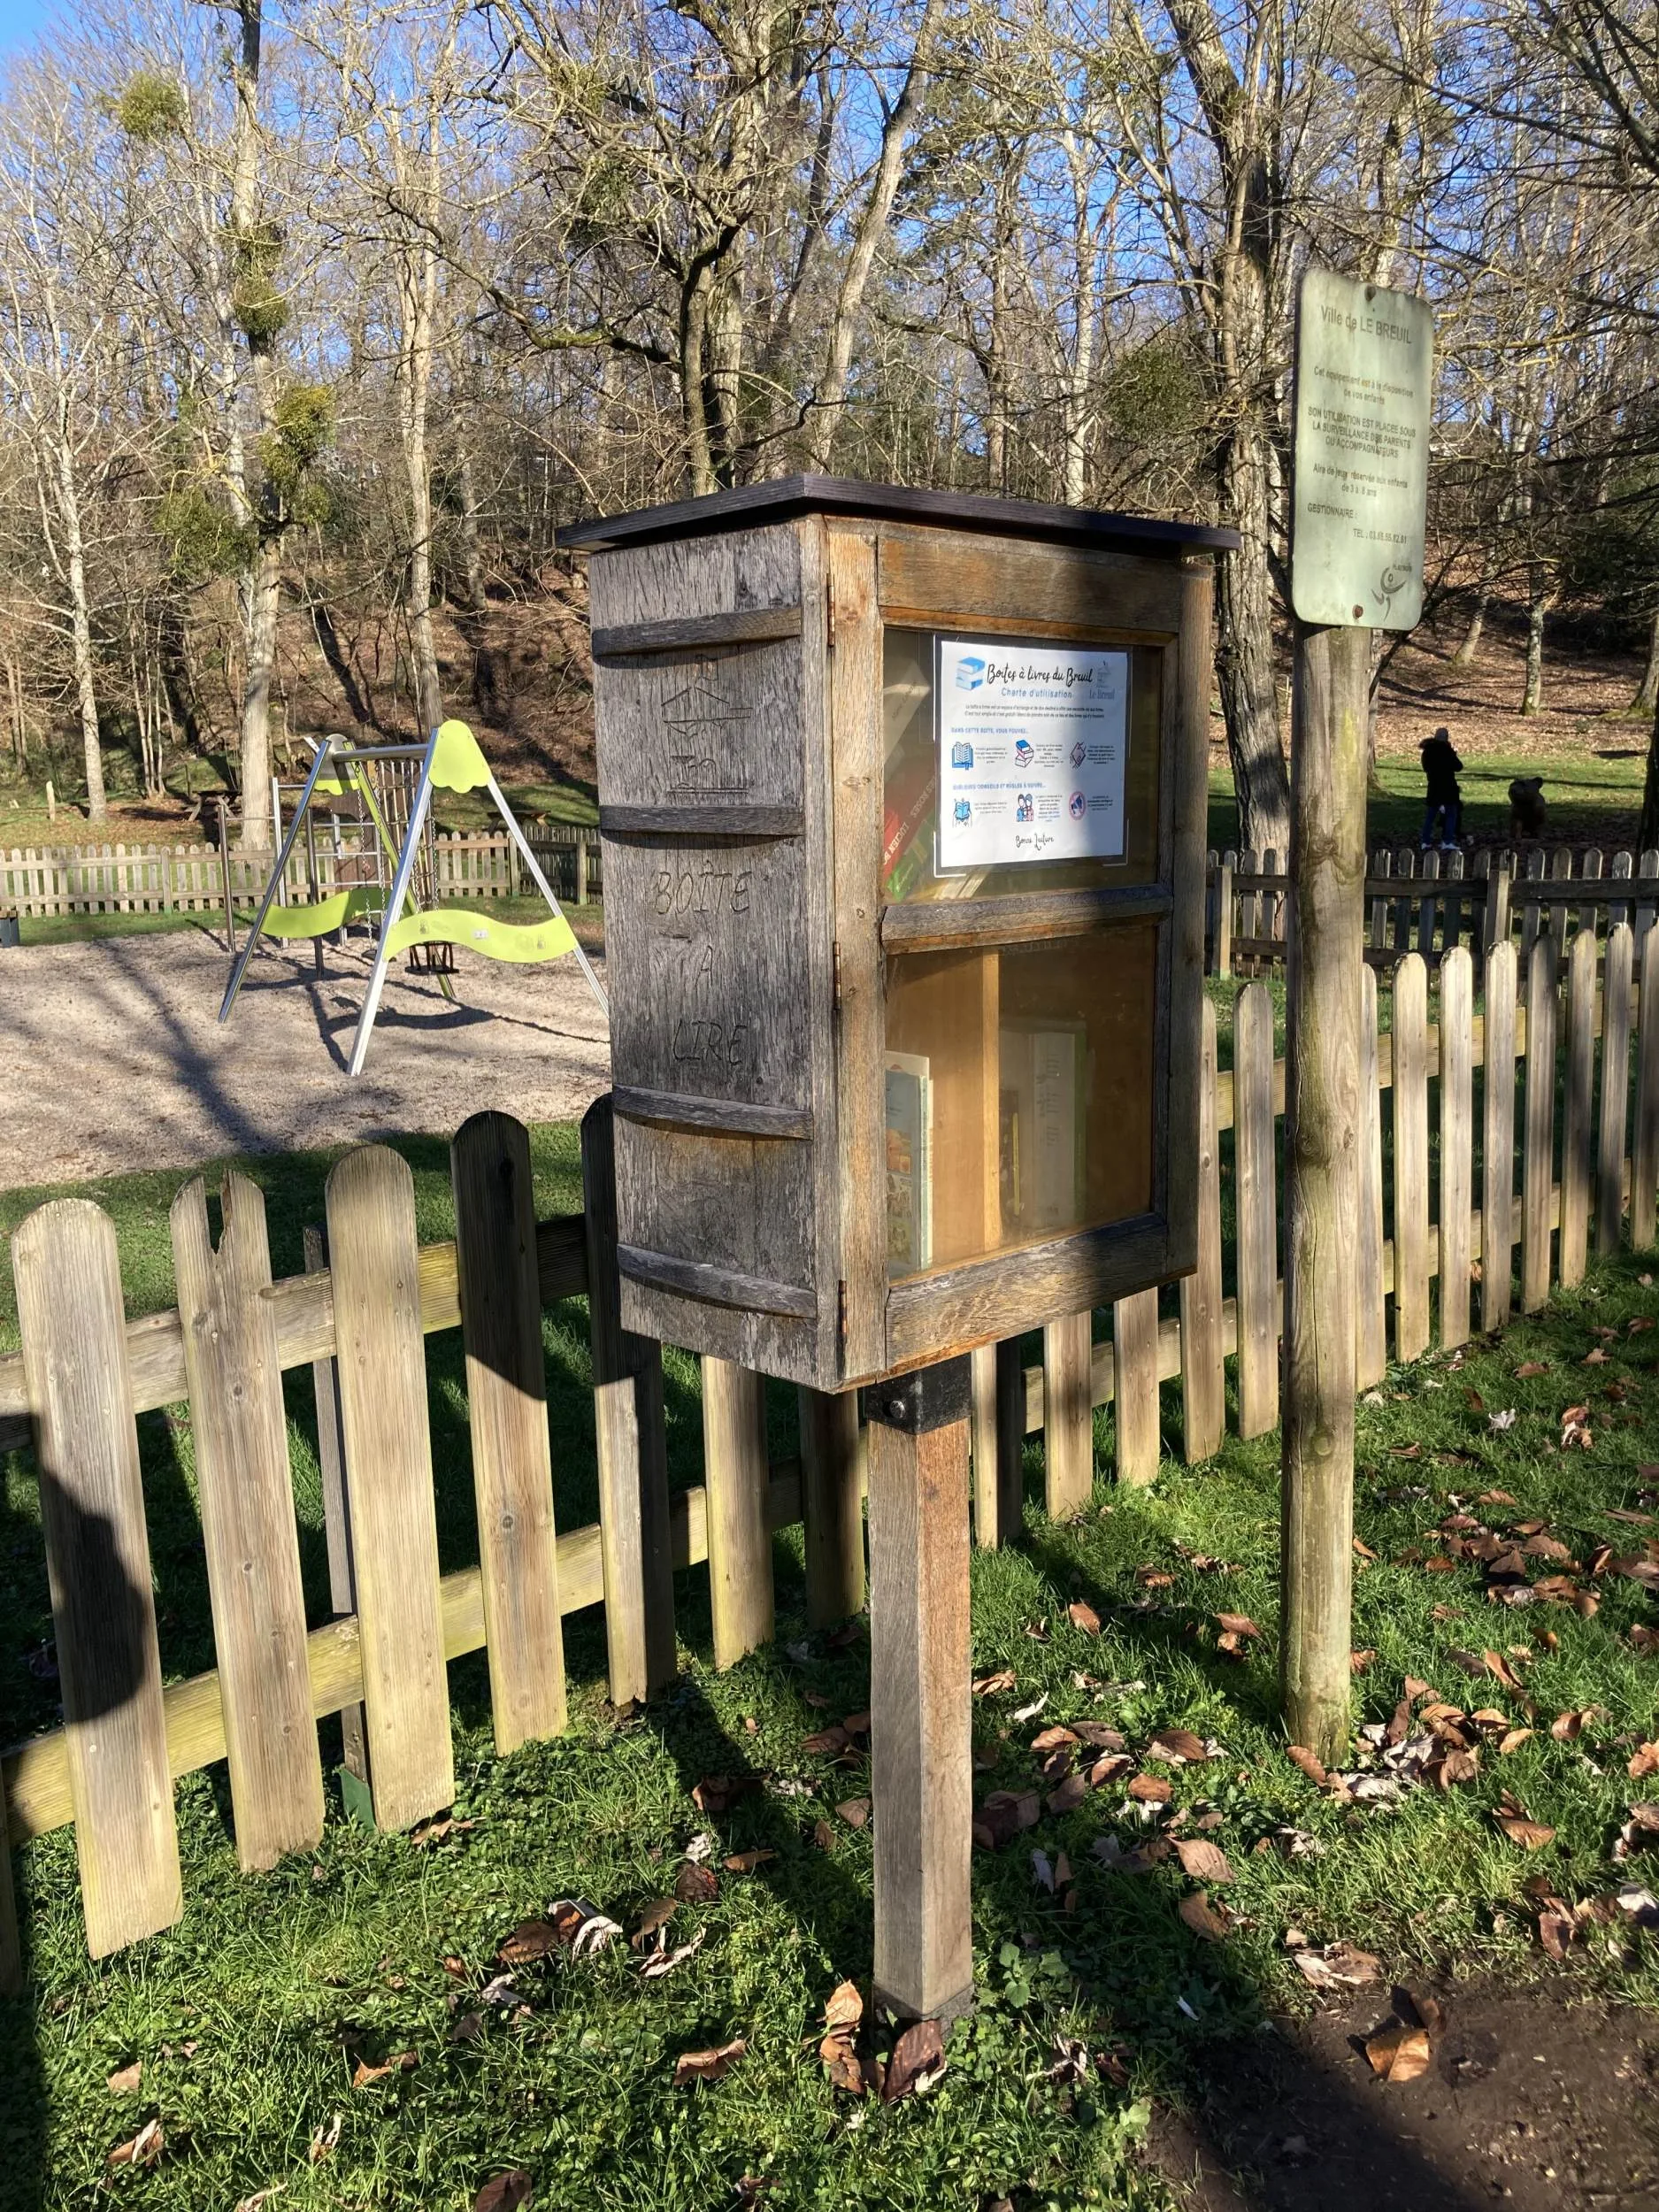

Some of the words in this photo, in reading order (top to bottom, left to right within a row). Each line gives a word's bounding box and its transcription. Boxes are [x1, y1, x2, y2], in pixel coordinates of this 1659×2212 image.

[1321, 304, 1342, 326] Ville
[1345, 313, 1357, 329] de
[1360, 316, 1373, 333] LE
[1376, 320, 1412, 344] BREUIL
[1308, 406, 1322, 418] SON
[1324, 410, 1360, 426] UTILISATION
[1363, 419, 1373, 428] EST
[1400, 426, 1416, 438] SOUS
[1313, 421, 1321, 430] LA
[1322, 423, 1369, 441] SURVEILLANCE
[1371, 434, 1383, 442] DES
[1384, 435, 1410, 449] PARENTS
[1313, 464, 1325, 474] Aire
[1327, 465, 1334, 476] de
[1341, 483, 1349, 493] de
[1308, 503, 1354, 518] GESTIONNAIRE
[1019, 666, 1025, 680] à
[1027, 665, 1050, 683] livres
[1053, 665, 1064, 680] du
[1066, 667, 1093, 687] Breuil
[1002, 687, 1026, 696] Charte
[1029, 689, 1072, 698] d'utilisation
[887, 821, 910, 852] LUCIEN
[672, 1019, 748, 1066] LIRE
